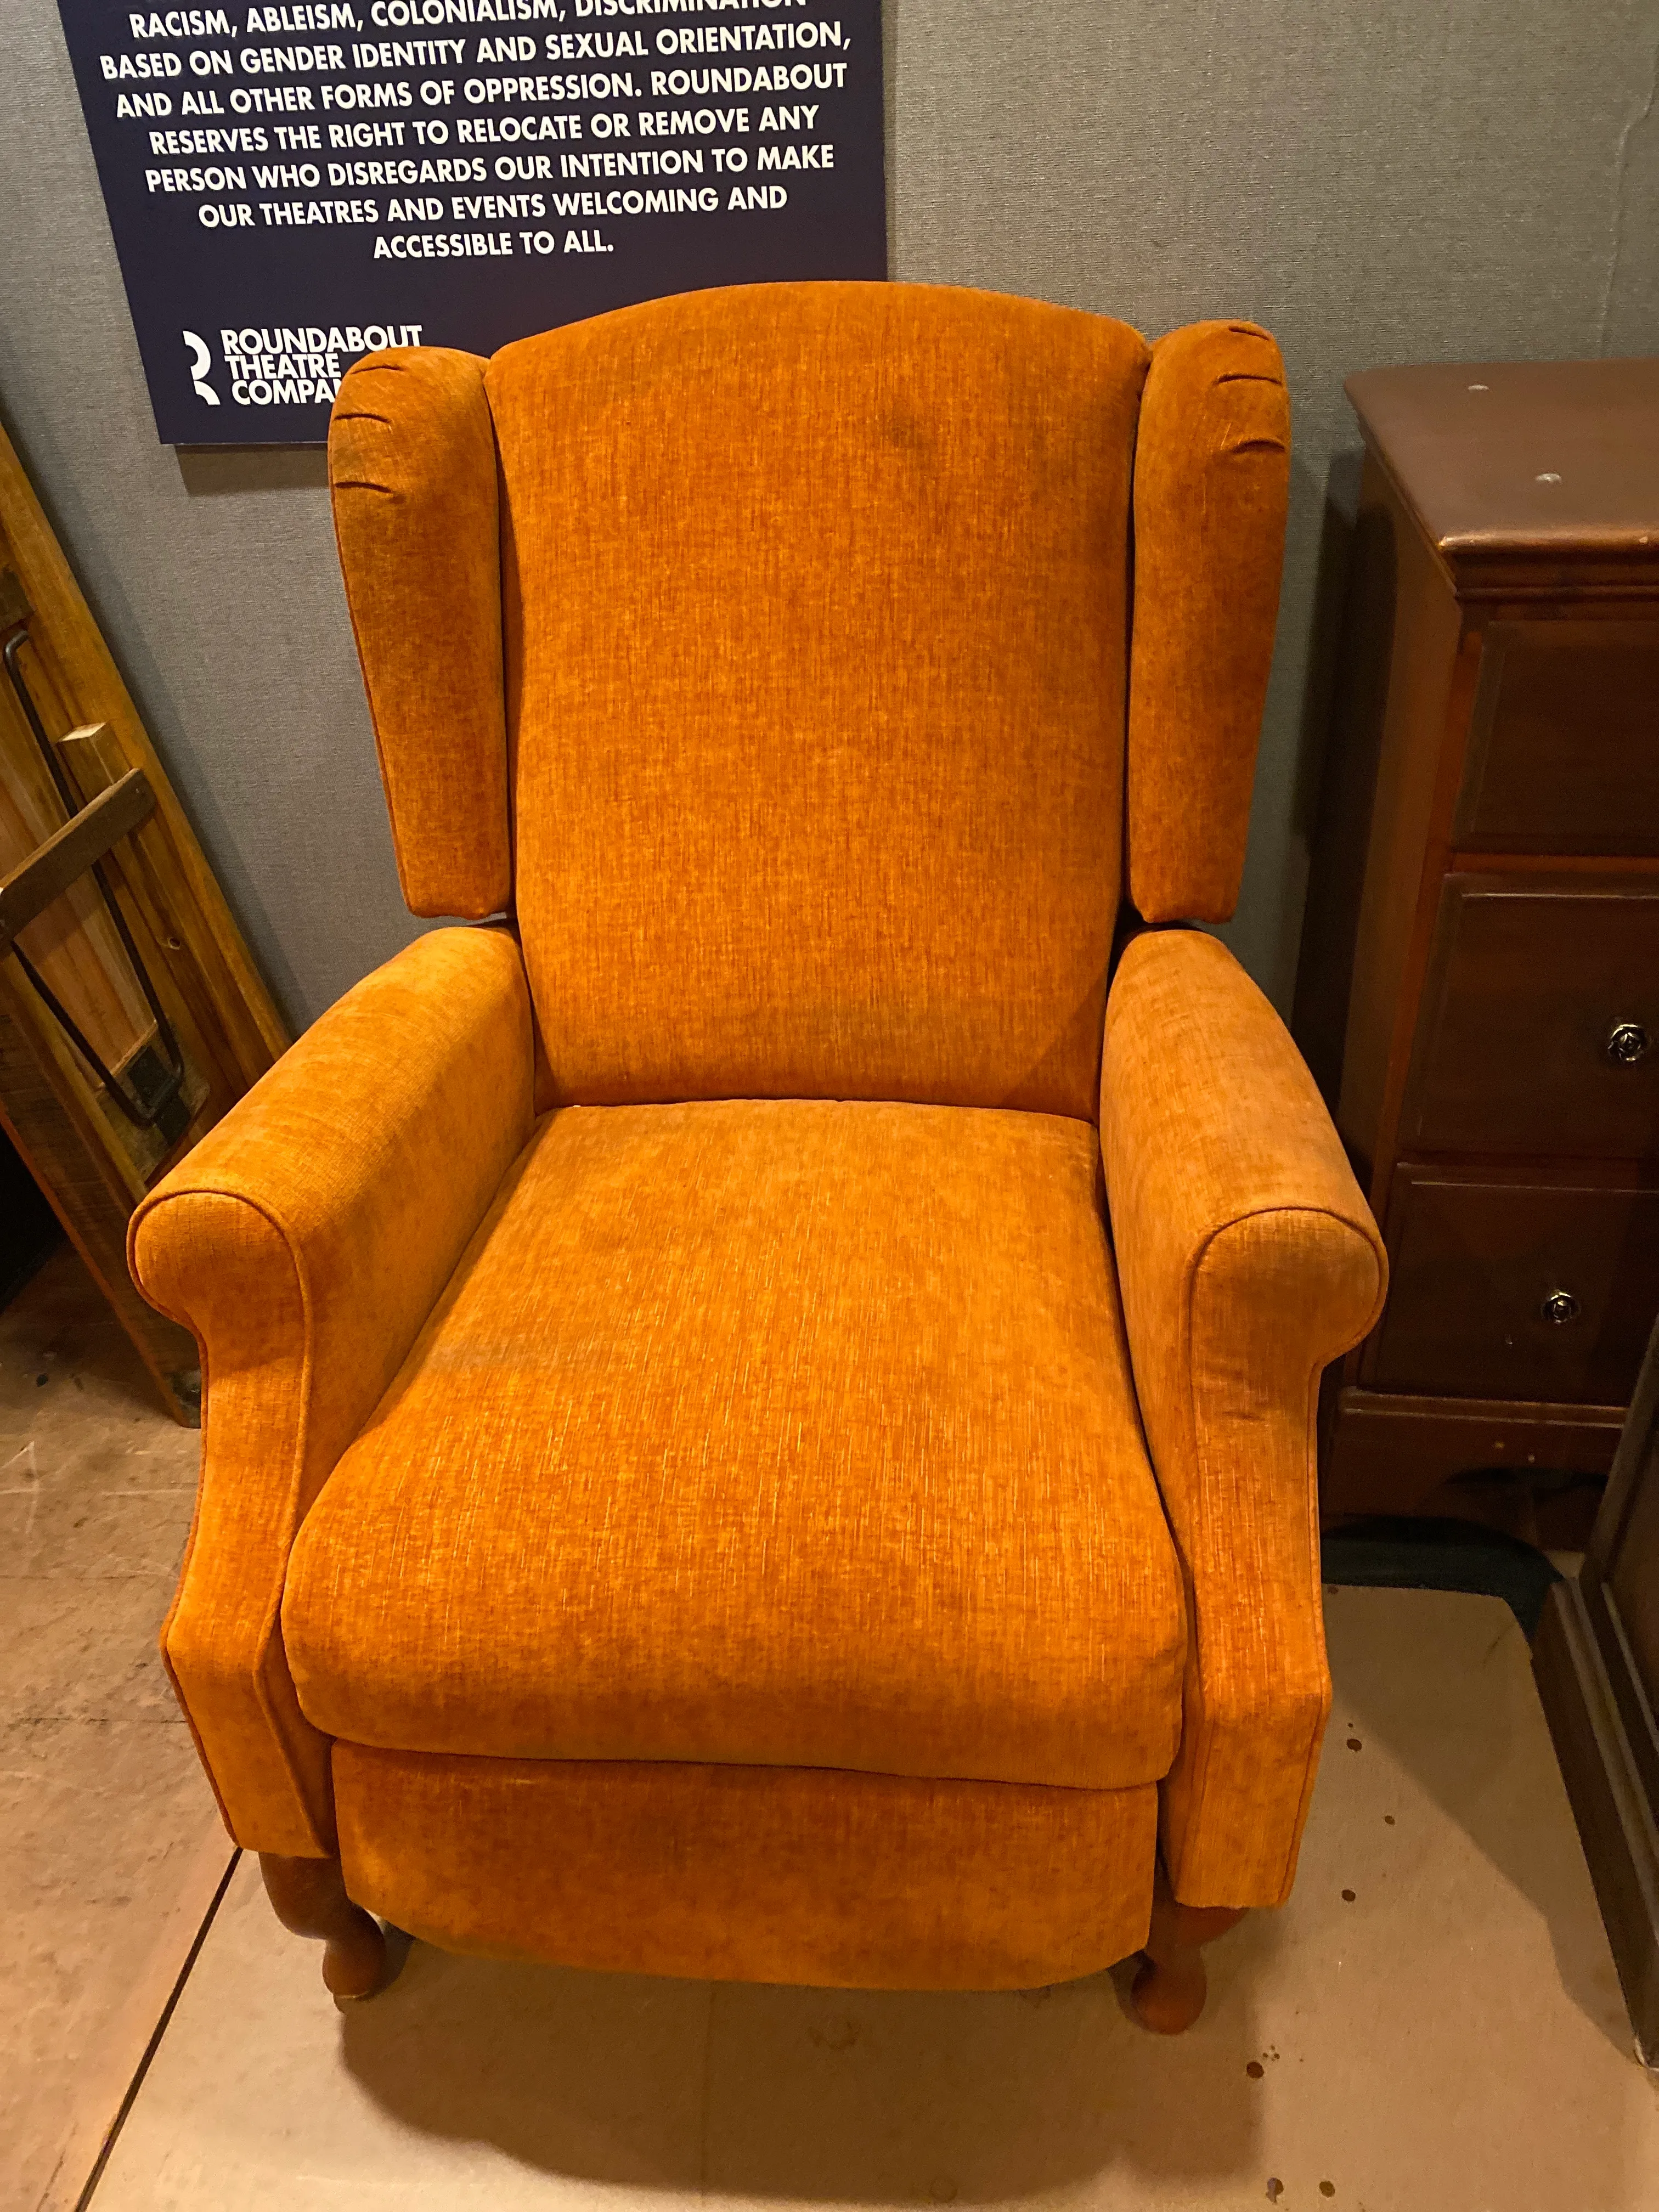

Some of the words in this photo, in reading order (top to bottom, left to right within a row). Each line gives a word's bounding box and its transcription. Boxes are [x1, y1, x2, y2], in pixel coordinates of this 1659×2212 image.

[129, 9, 238, 38] RACISM,
[246, 3, 363, 33] ABLEISM,
[371, 0, 566, 27] COLONIALISM,
[574, 0, 806, 17] DISCRIM
[99, 52, 182, 80] BASED
[189, 49, 233, 76] ON
[240, 45, 346, 74] GENDER
[352, 38, 466, 69] IDENTITY
[477, 36, 537, 63] AND
[545, 31, 649, 60] SEXUAL
[656, 21, 851, 55] ORIENTATION,
[117, 92, 172, 118] AND
[182, 90, 225, 115] ALL
[230, 86, 315, 114] OTHER
[320, 81, 413, 110] FORMS
[420, 80, 455, 105] OF
[464, 72, 642, 104] OPPRESSION.
[651, 63, 847, 95] ROUNDABOUT
[149, 127, 268, 154] RESERVES
[273, 125, 322, 150] THE
[328, 122, 405, 148] RIGHT
[412, 120, 449, 144] TO
[456, 115, 583, 143] RELOCATE
[590, 113, 631, 138] OR
[638, 108, 749, 136] REMOVE
[758, 105, 819, 131] ANY
[145, 166, 247, 193] PERSON
[251, 163, 320, 188] WHO
[327, 157, 487, 186] DISREGARDS
[494, 155, 554, 180] OUR
[560, 149, 703, 178] INTENTION
[711, 147, 748, 172] TO
[757, 144, 834, 171] MAKE
[199, 204, 256, 228] OUR
[258, 199, 379, 225] THEATRES
[387, 198, 444, 222] AND
[451, 194, 546, 219] EVENTS
[551, 187, 719, 216] WELCOMING
[727, 185, 787, 210] AND
[374, 233, 513, 258] ACCESSIBLE
[519, 230, 555, 255] TO
[563, 229, 614, 253] ALL.
[220, 325, 422, 355] ROUNDABOUT
[224, 353, 342, 380] THEATRE
[232, 378, 342, 405] COMPA
